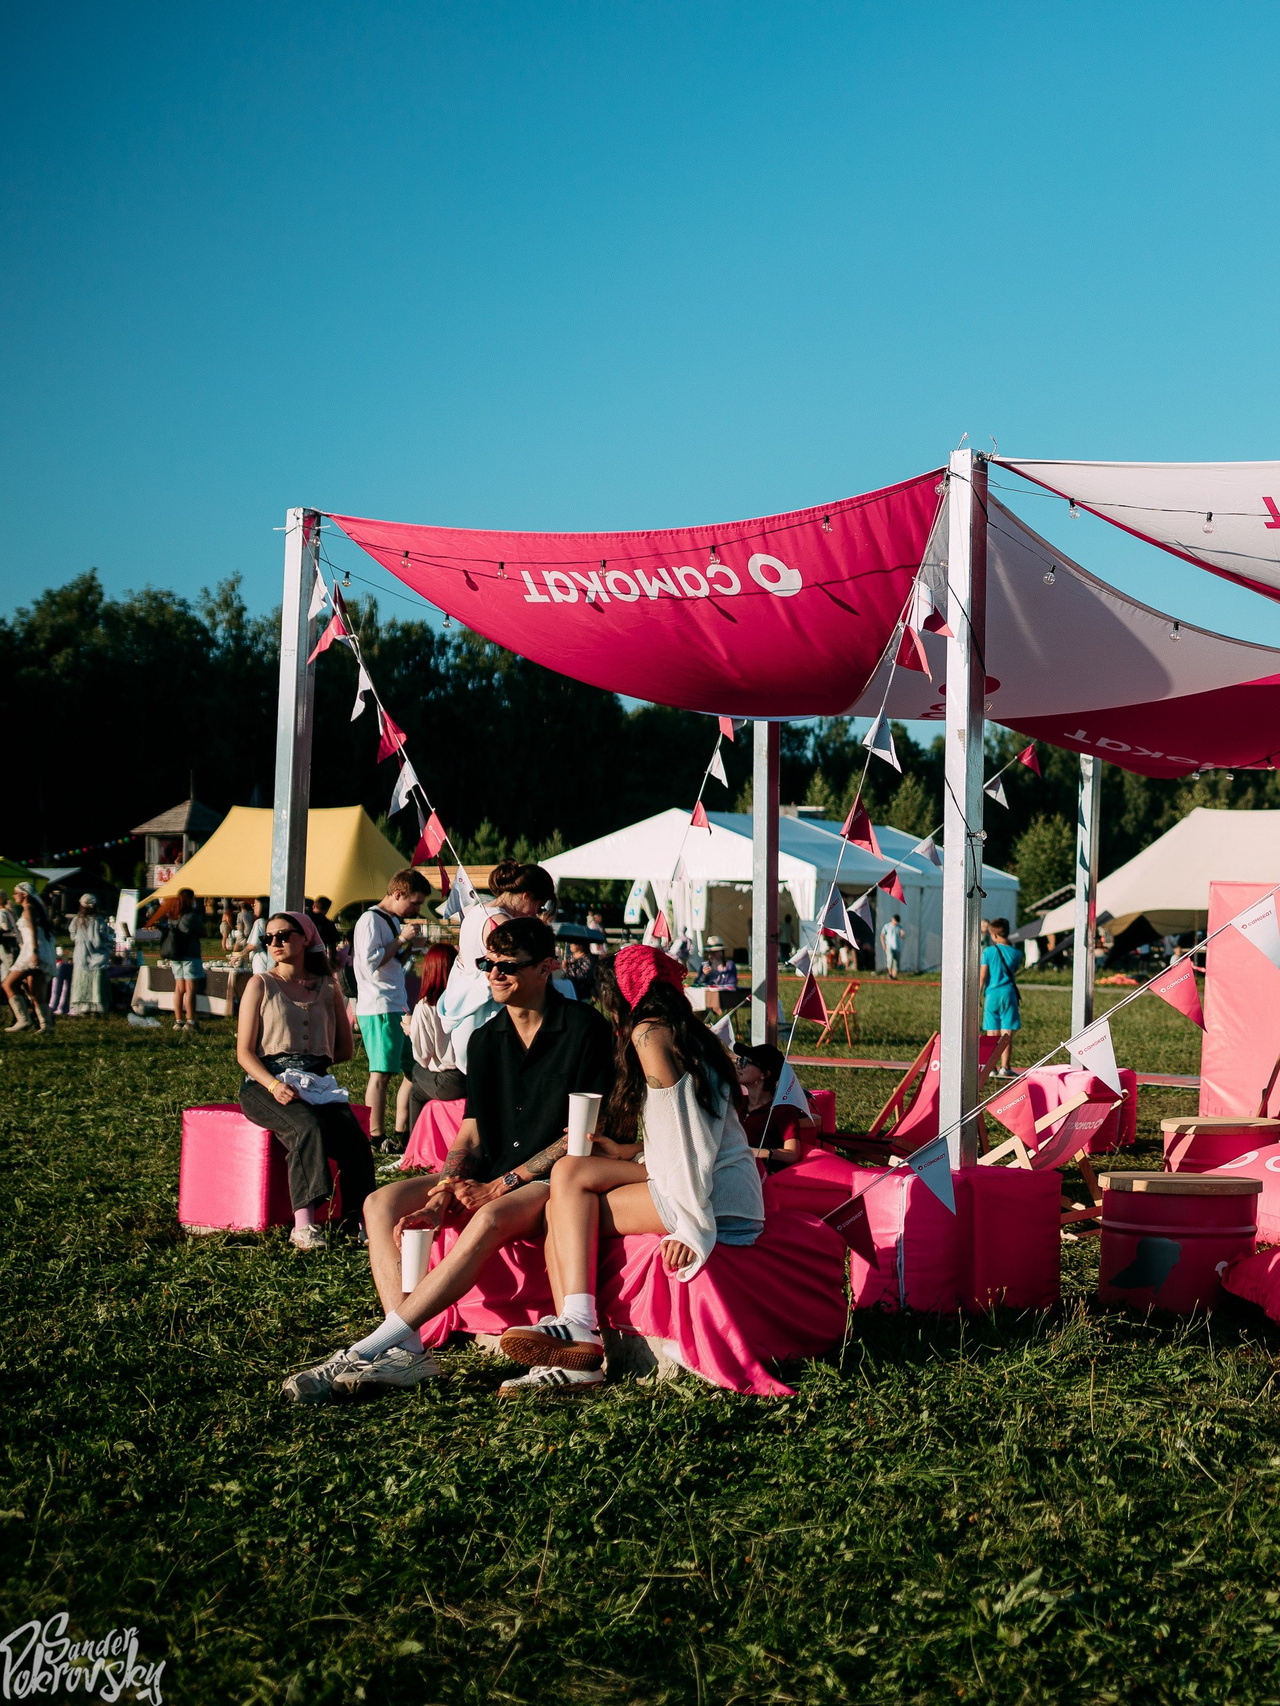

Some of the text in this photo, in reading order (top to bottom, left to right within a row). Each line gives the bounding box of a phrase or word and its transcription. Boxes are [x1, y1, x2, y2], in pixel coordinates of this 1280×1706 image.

[520, 564, 742, 603] самокат
[1247, 910, 1273, 926] самокат
[1166, 972, 1191, 990] самокат
[1083, 1034, 1107, 1052] самокат
[1002, 1093, 1027, 1111] самокат
[923, 1152, 946, 1168] самокат
[841, 1210, 864, 1228] самокат
